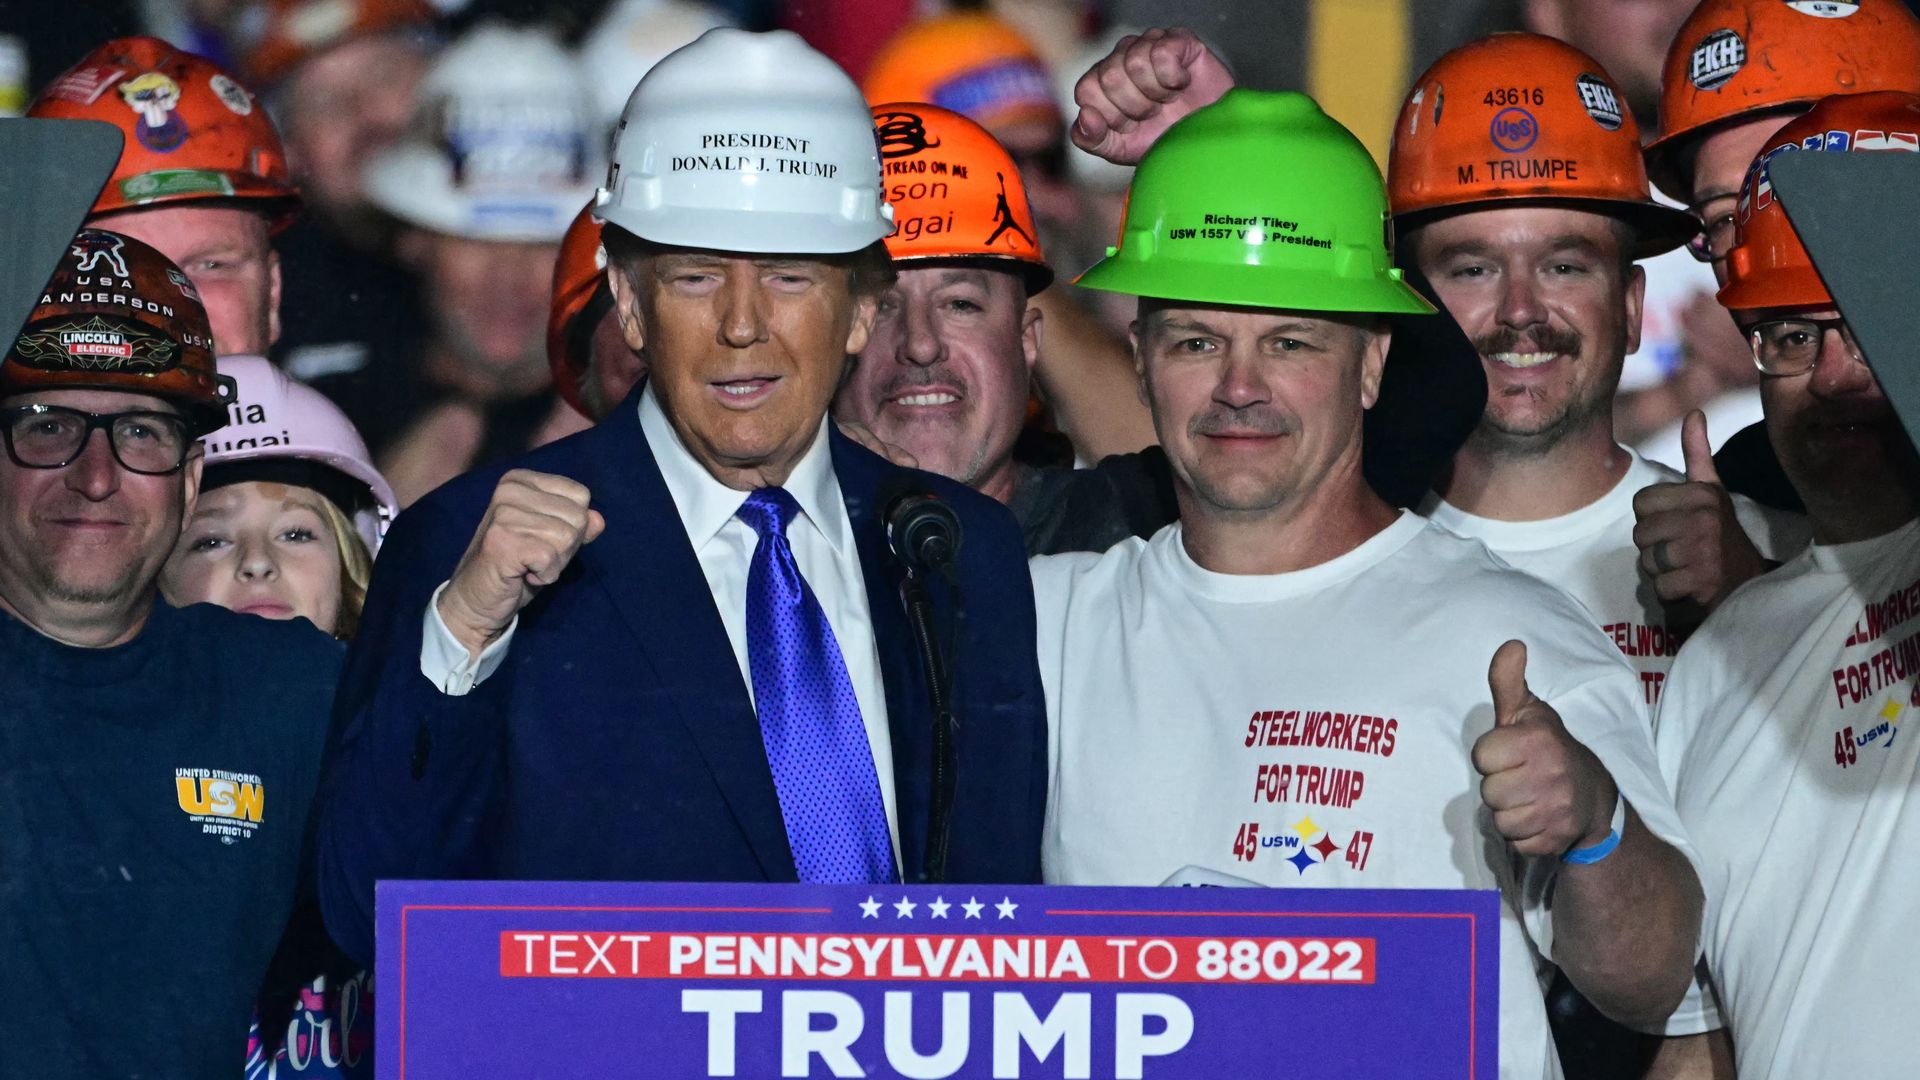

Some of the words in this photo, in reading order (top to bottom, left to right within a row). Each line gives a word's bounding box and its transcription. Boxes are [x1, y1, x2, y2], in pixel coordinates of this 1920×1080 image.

[1484, 89, 1544, 107] 43616
[702, 133, 810, 154] PRESIDENT
[672, 155, 750, 172] DONALD
[755, 157, 770, 172] J.
[776, 158, 838, 179] TRUMP
[886, 160, 926, 176] TREAD
[931, 161, 947, 176] ON
[952, 164, 968, 179] ME
[1457, 165, 1479, 184] M.
[1487, 159, 1578, 181] TRUMPE
[884, 182, 948, 203] son
[885, 210, 954, 242] ugai
[1204, 214, 1257, 226] Richard
[1262, 217, 1299, 232] Tikey
[1170, 229, 1196, 240] USW
[1200, 228, 1232, 239] 1557
[1272, 232, 1332, 249] President
[77, 276, 132, 289] USA
[41, 292, 174, 317] ANDERSON
[63, 333, 121, 345] LINCOLN
[76, 345, 126, 355] ELECTRIC
[227, 400, 266, 427] ia
[1832, 661, 1873, 710] FOR
[1244, 711, 1398, 757] STEELWORKERS
[1834, 726, 1857, 769] 45
[1856, 721, 1889, 747] USW
[175, 768, 210, 778] UNITED
[1254, 764, 1292, 803] FOR
[1296, 765, 1364, 808] TRUMP
[176, 777, 264, 822] USW
[203, 824, 241, 836] DISTRICT
[243, 829, 251, 838] 10
[1233, 823, 1259, 862] 45
[1261, 837, 1299, 848] USW
[1345, 831, 1374, 871] 47
[514, 934, 651, 974] TEXT
[669, 936, 1090, 978] PENNSYLVANIA
[1106, 939, 1178, 979] TO
[1196, 940, 1363, 981] 88022
[681, 989, 1194, 1079] TRUMP
